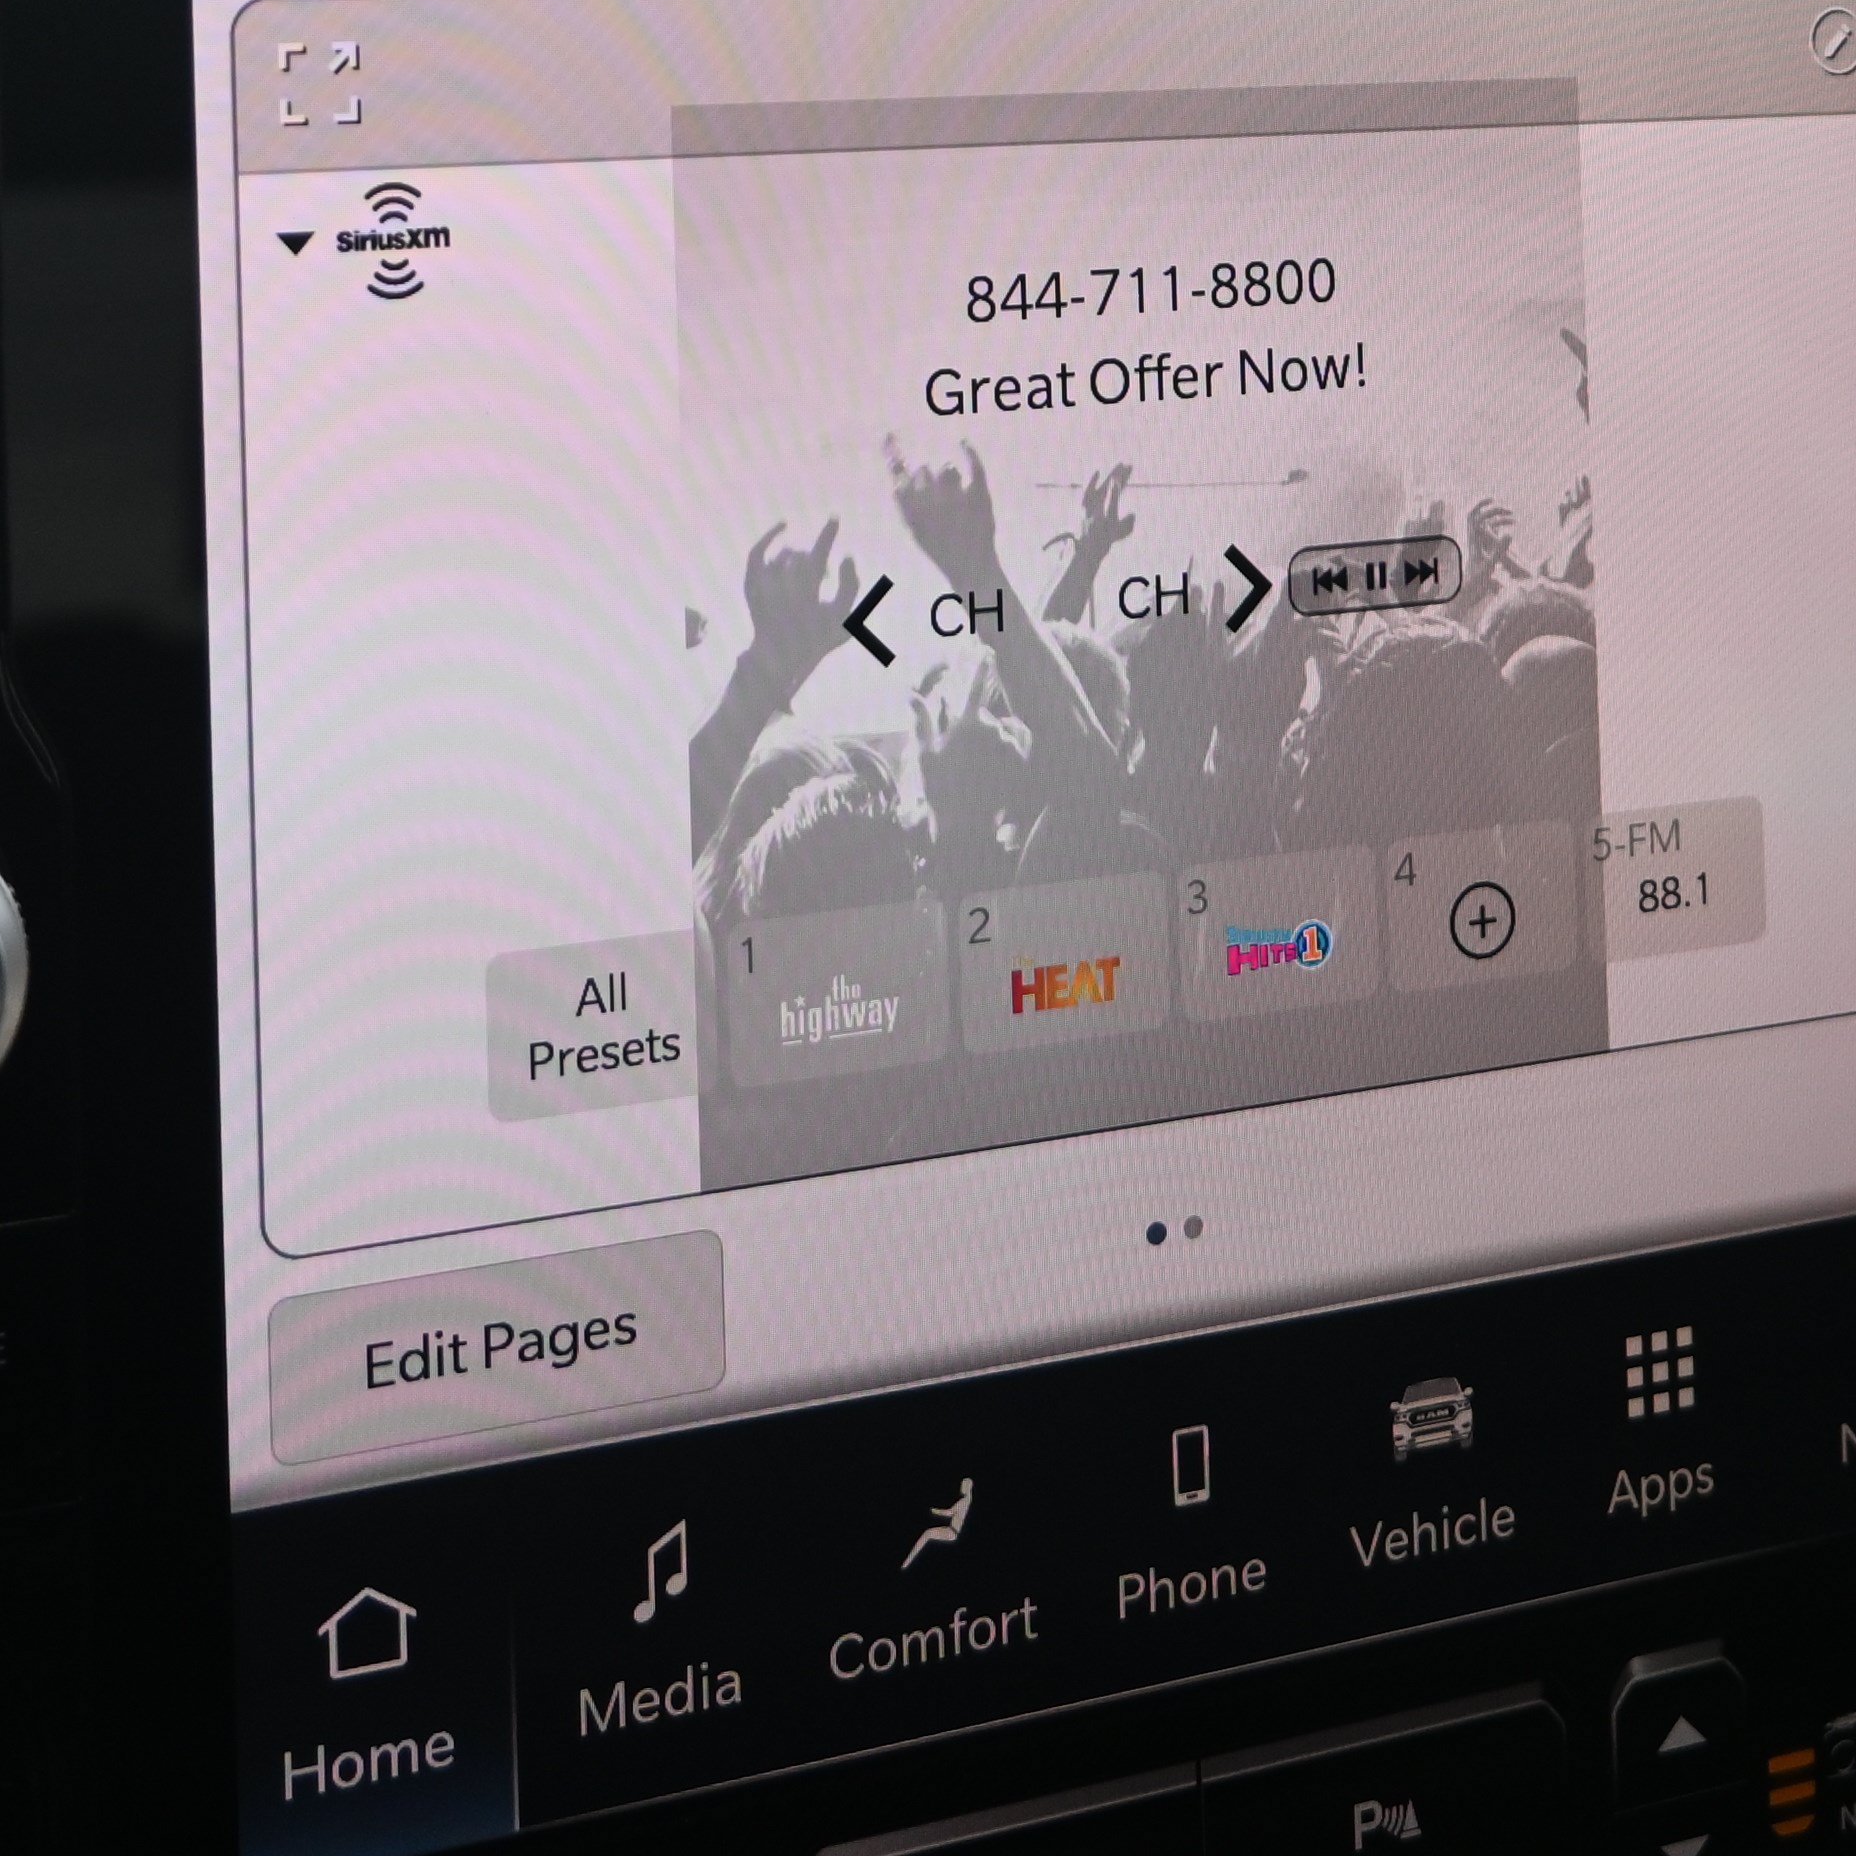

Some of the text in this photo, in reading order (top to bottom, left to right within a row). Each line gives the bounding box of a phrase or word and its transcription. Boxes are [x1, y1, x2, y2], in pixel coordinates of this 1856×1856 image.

[966, 257, 1337, 323] 844-711-8800
[925, 342, 1368, 416] Great Offer Now!
[929, 589, 1005, 637] CH
[1118, 572, 1190, 619] CH
[1592, 819, 1682, 861] 5-FM
[1394, 851, 1417, 887] 4
[1638, 872, 1709, 913] 88.1
[1187, 879, 1208, 914] 3
[968, 906, 992, 944] 2
[741, 936, 753, 974] 1
[575, 971, 627, 1017] All
[1011, 956, 1121, 1014] HEAT
[780, 995, 900, 1043] highway
[529, 1028, 681, 1081] Presets
[365, 1309, 639, 1390] Edit Pages
[1607, 1462, 1716, 1520] Apps
[1350, 1497, 1517, 1569] Vehicle
[1117, 1556, 1268, 1621] Phone
[829, 1597, 1039, 1680] Comfort
[578, 1662, 744, 1737] Media
[283, 1727, 456, 1801] Home
